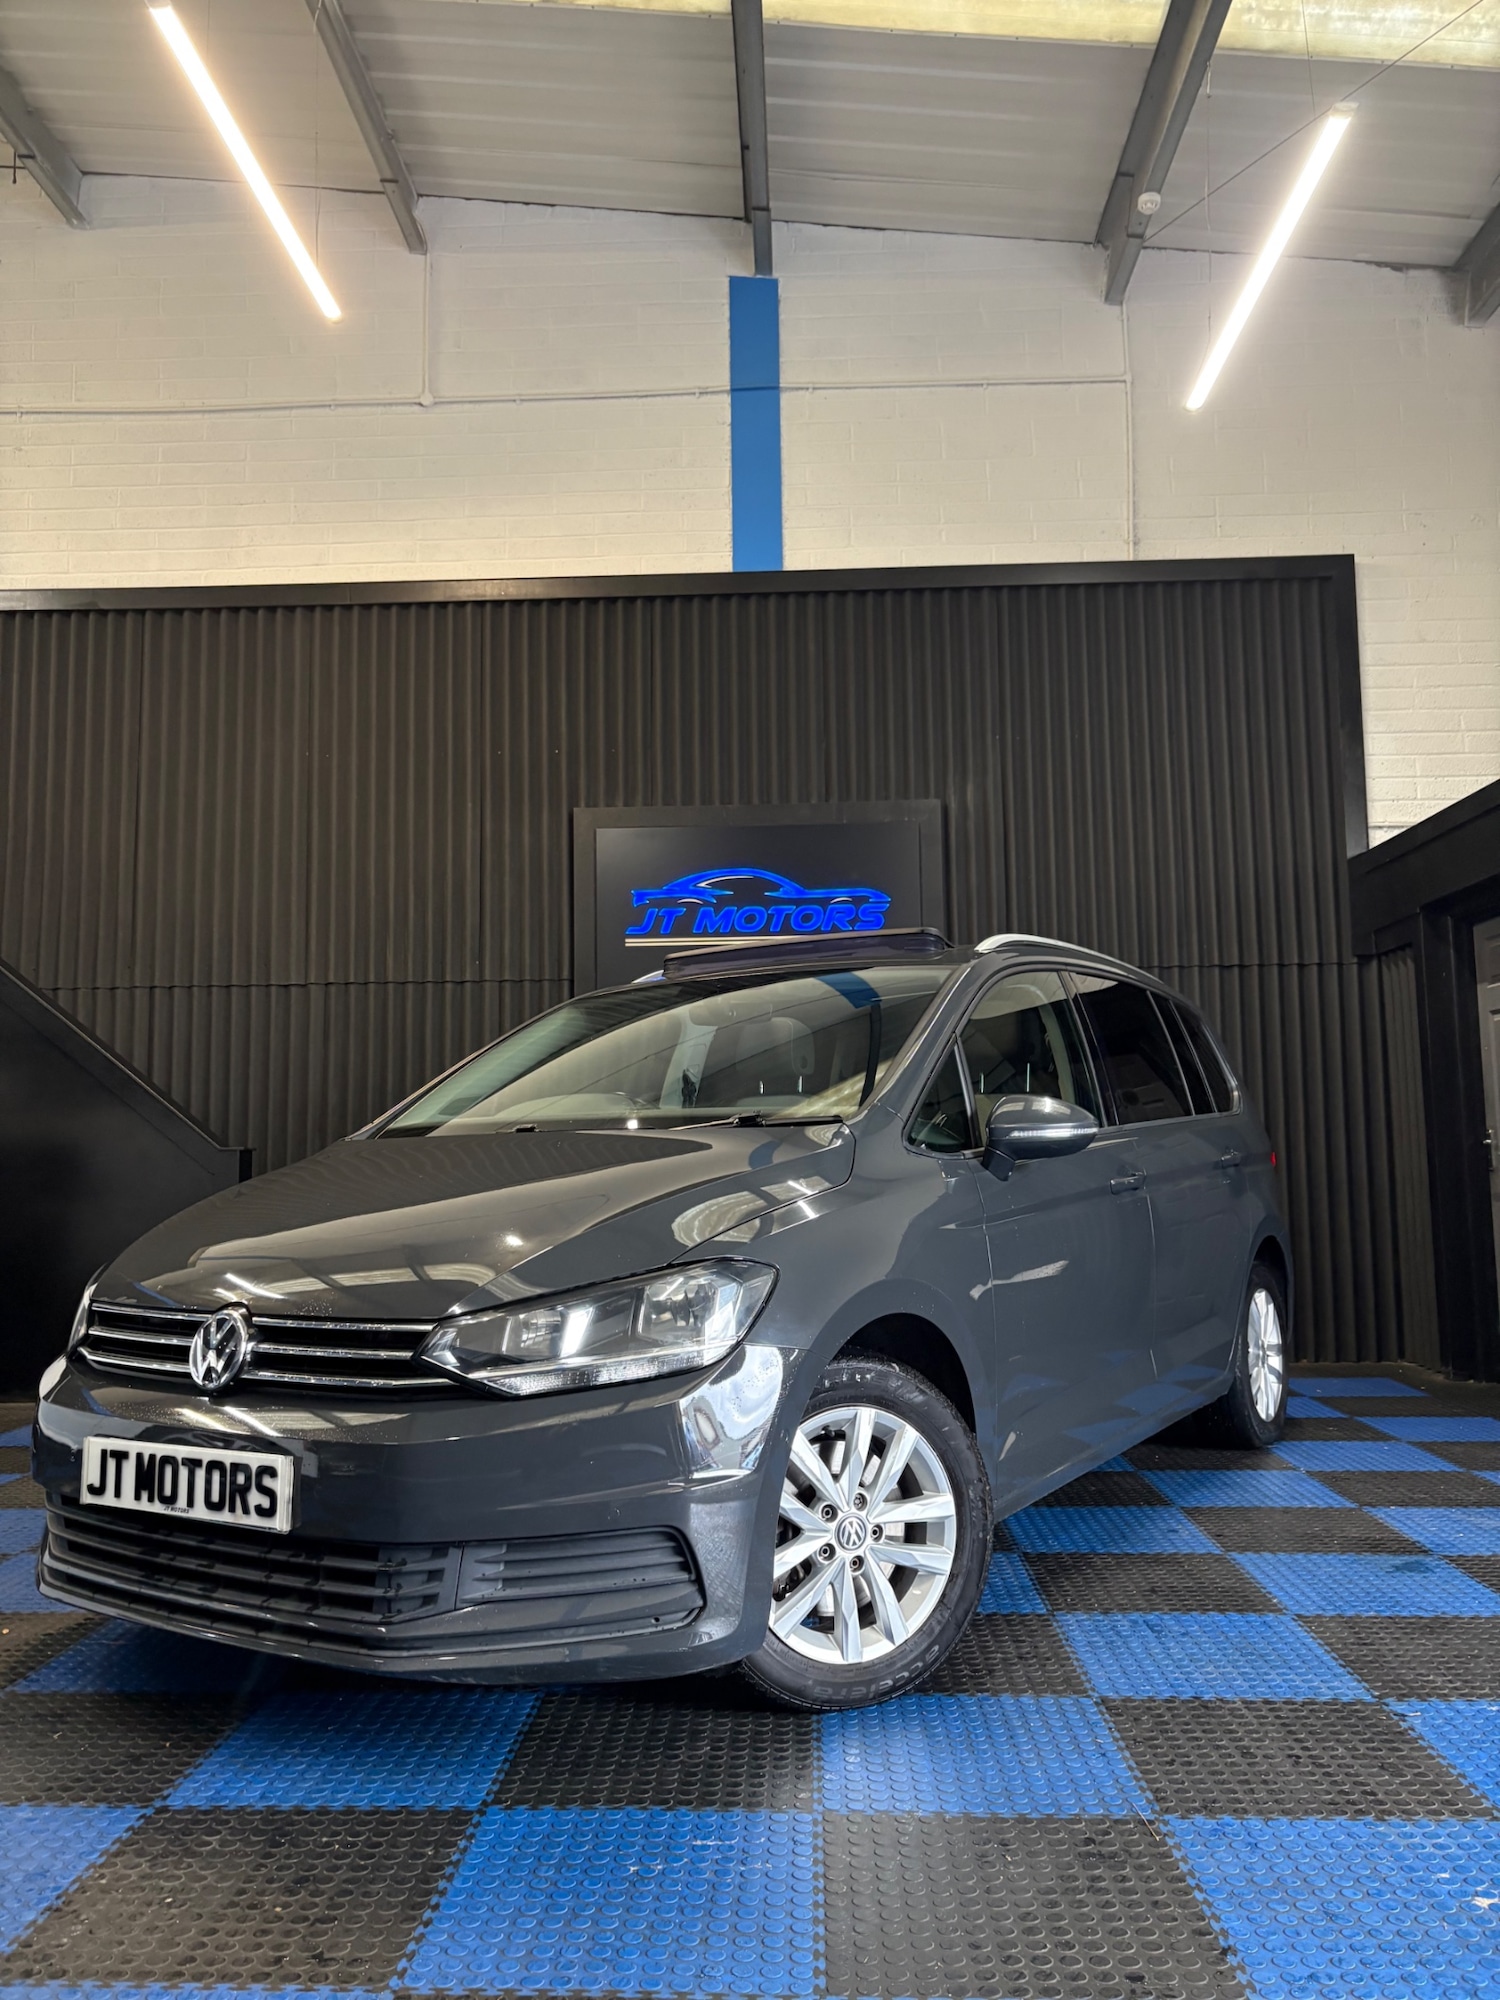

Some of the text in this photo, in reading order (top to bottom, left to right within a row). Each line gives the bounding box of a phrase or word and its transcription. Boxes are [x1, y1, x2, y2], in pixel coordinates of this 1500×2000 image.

[625, 903, 890, 935] JT MOTORS
[87, 1448, 278, 1518] JT MOTORS
